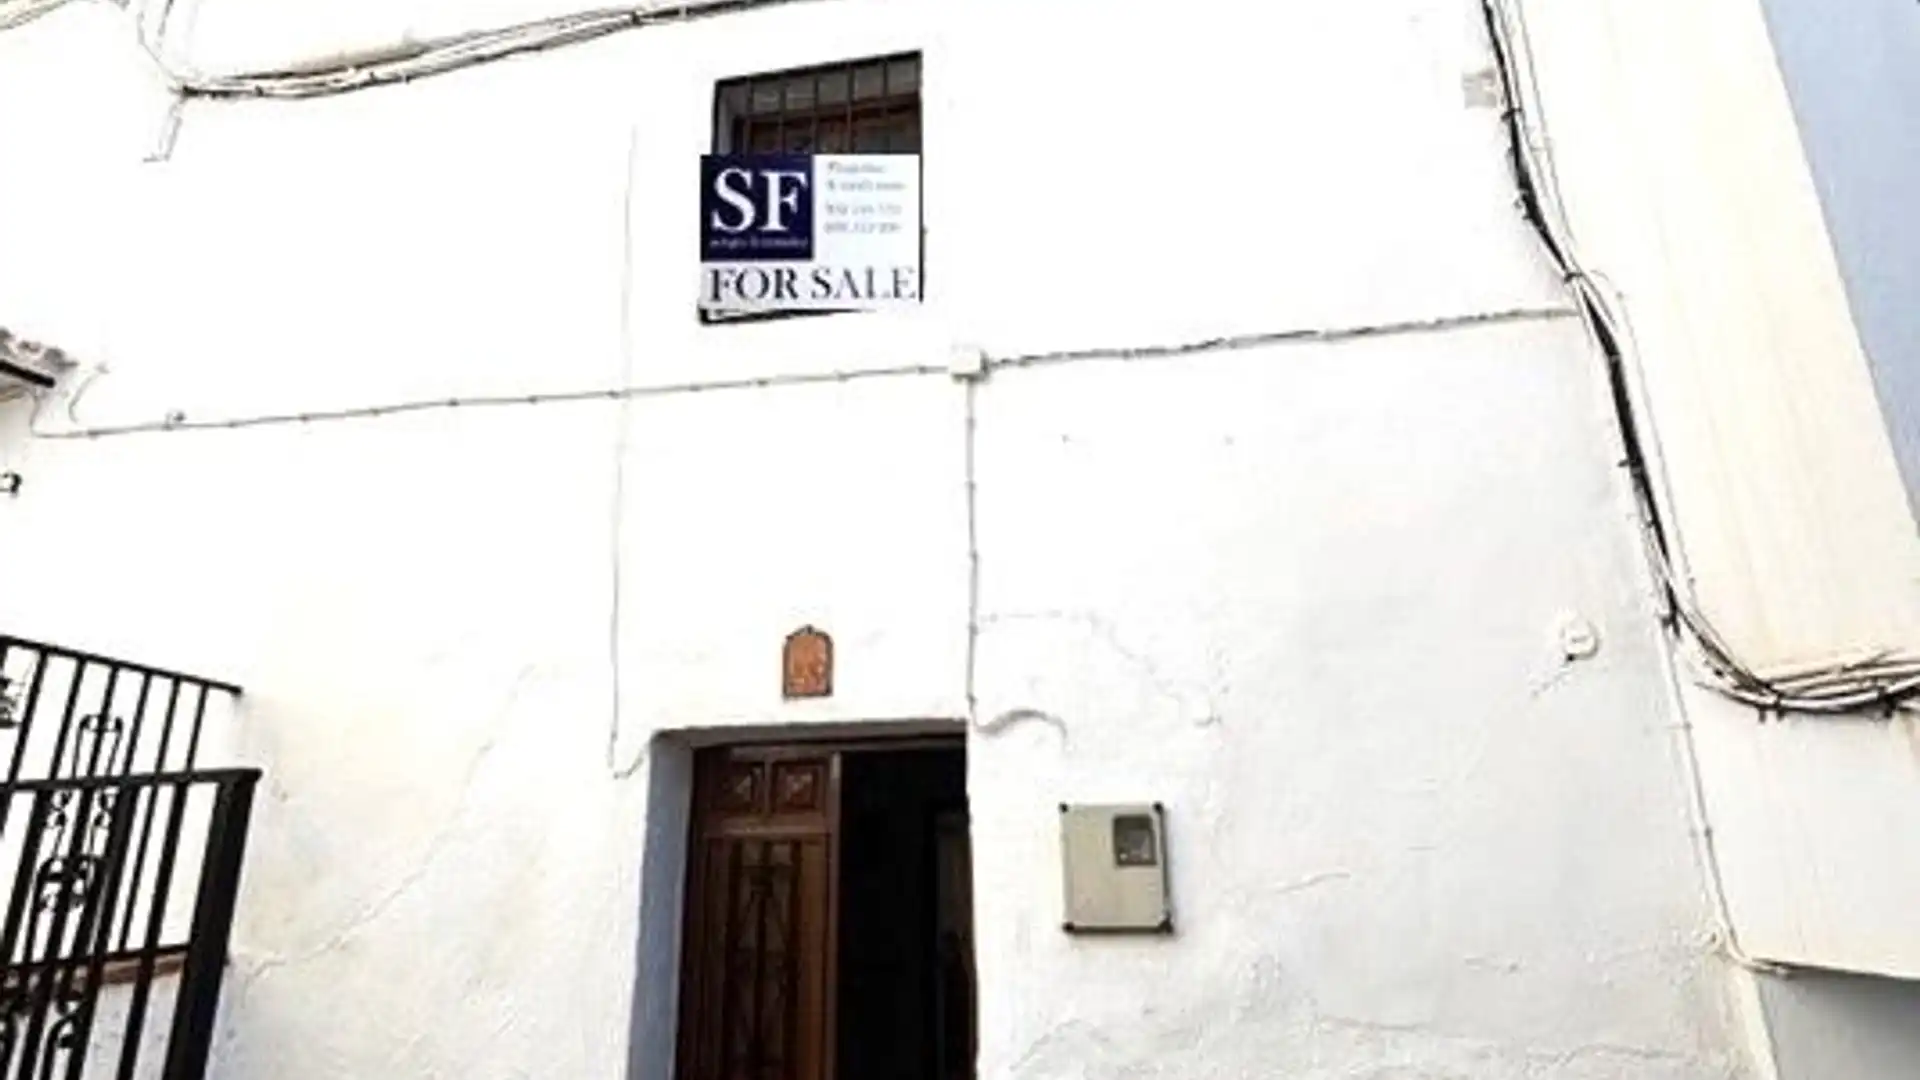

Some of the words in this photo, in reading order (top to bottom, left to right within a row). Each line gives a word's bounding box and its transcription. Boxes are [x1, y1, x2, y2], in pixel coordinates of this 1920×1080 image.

[710, 167, 809, 234] SF
[709, 267, 799, 302] FOR
[810, 265, 917, 300] SALE
